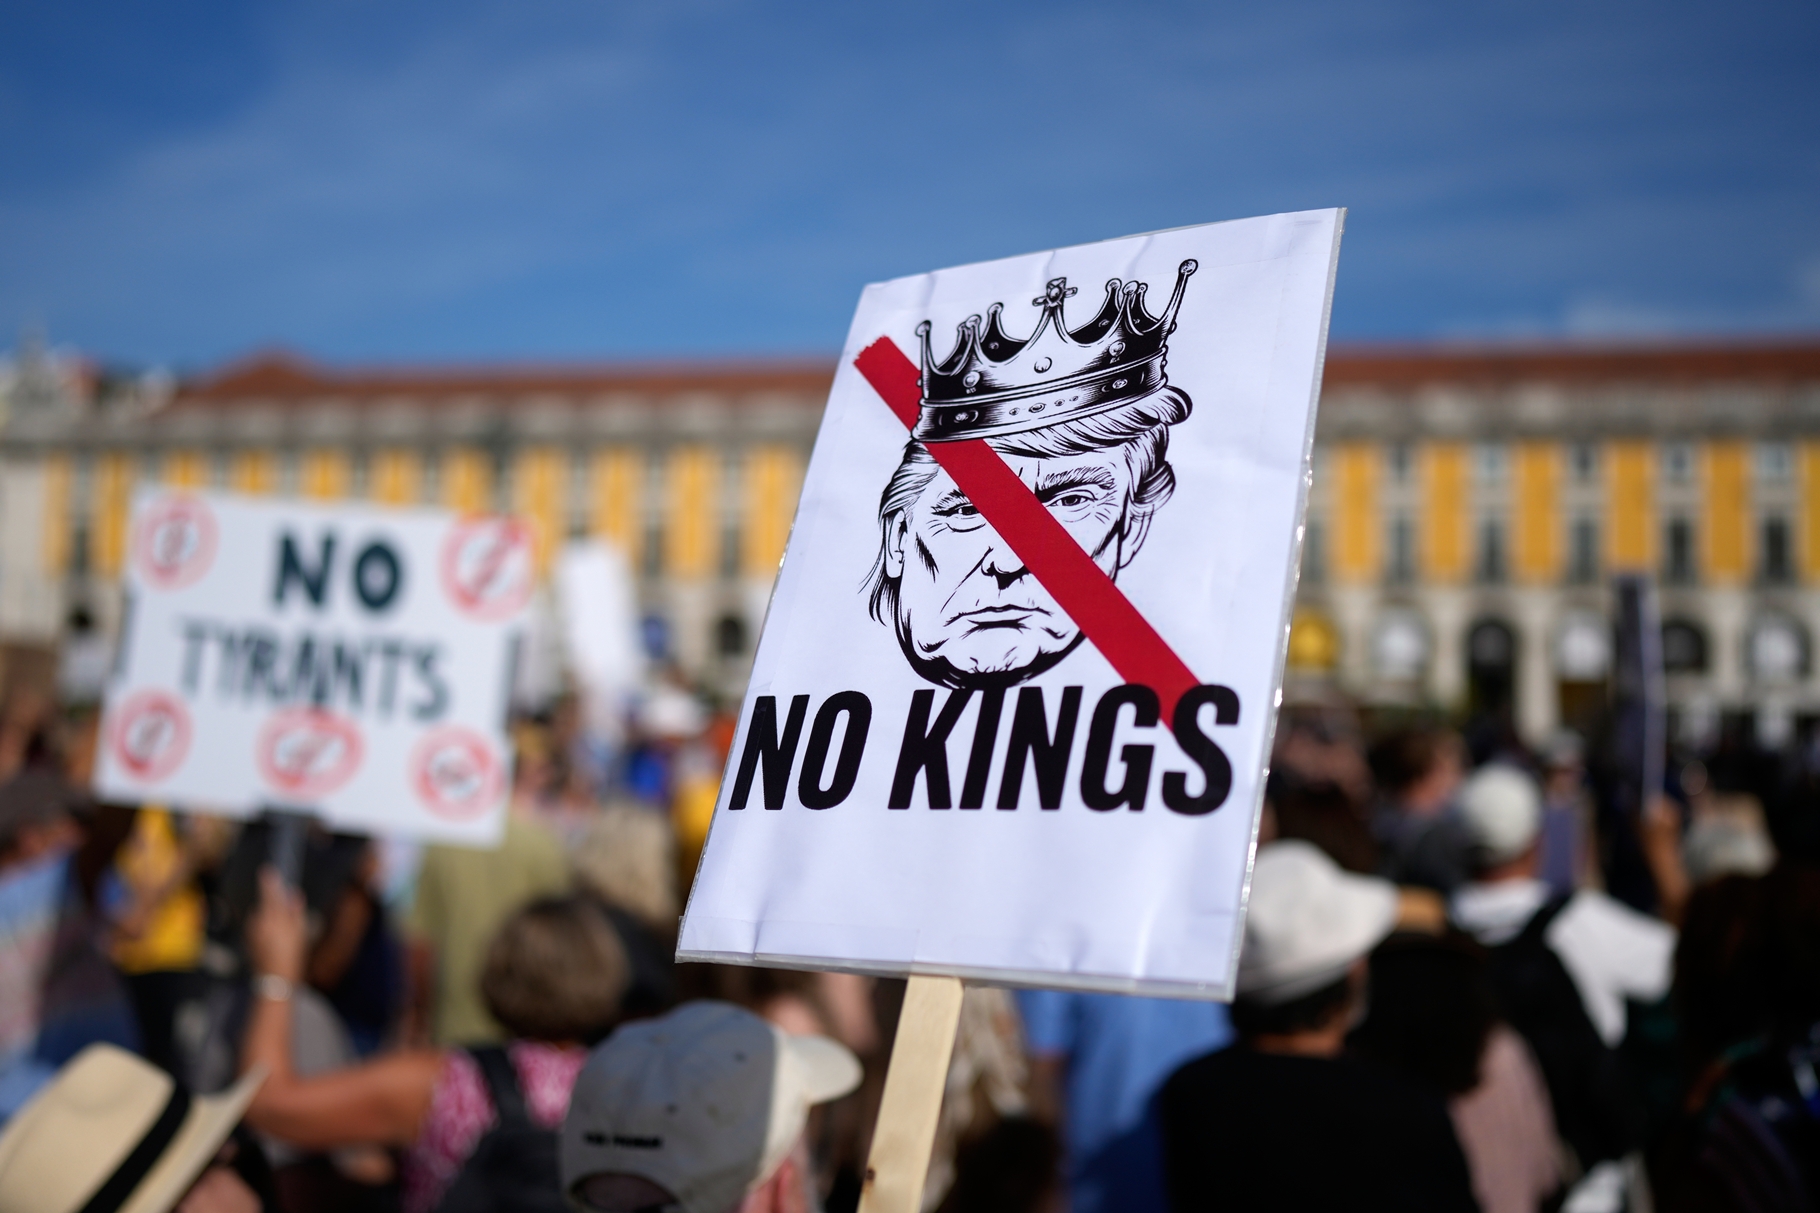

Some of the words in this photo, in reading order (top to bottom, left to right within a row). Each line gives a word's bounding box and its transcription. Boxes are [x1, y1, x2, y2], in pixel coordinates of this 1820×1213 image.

[271, 526, 406, 613] NO
[178, 616, 453, 724] TYRANTS
[728, 690, 873, 811] NO
[887, 683, 1241, 816] KINGS
